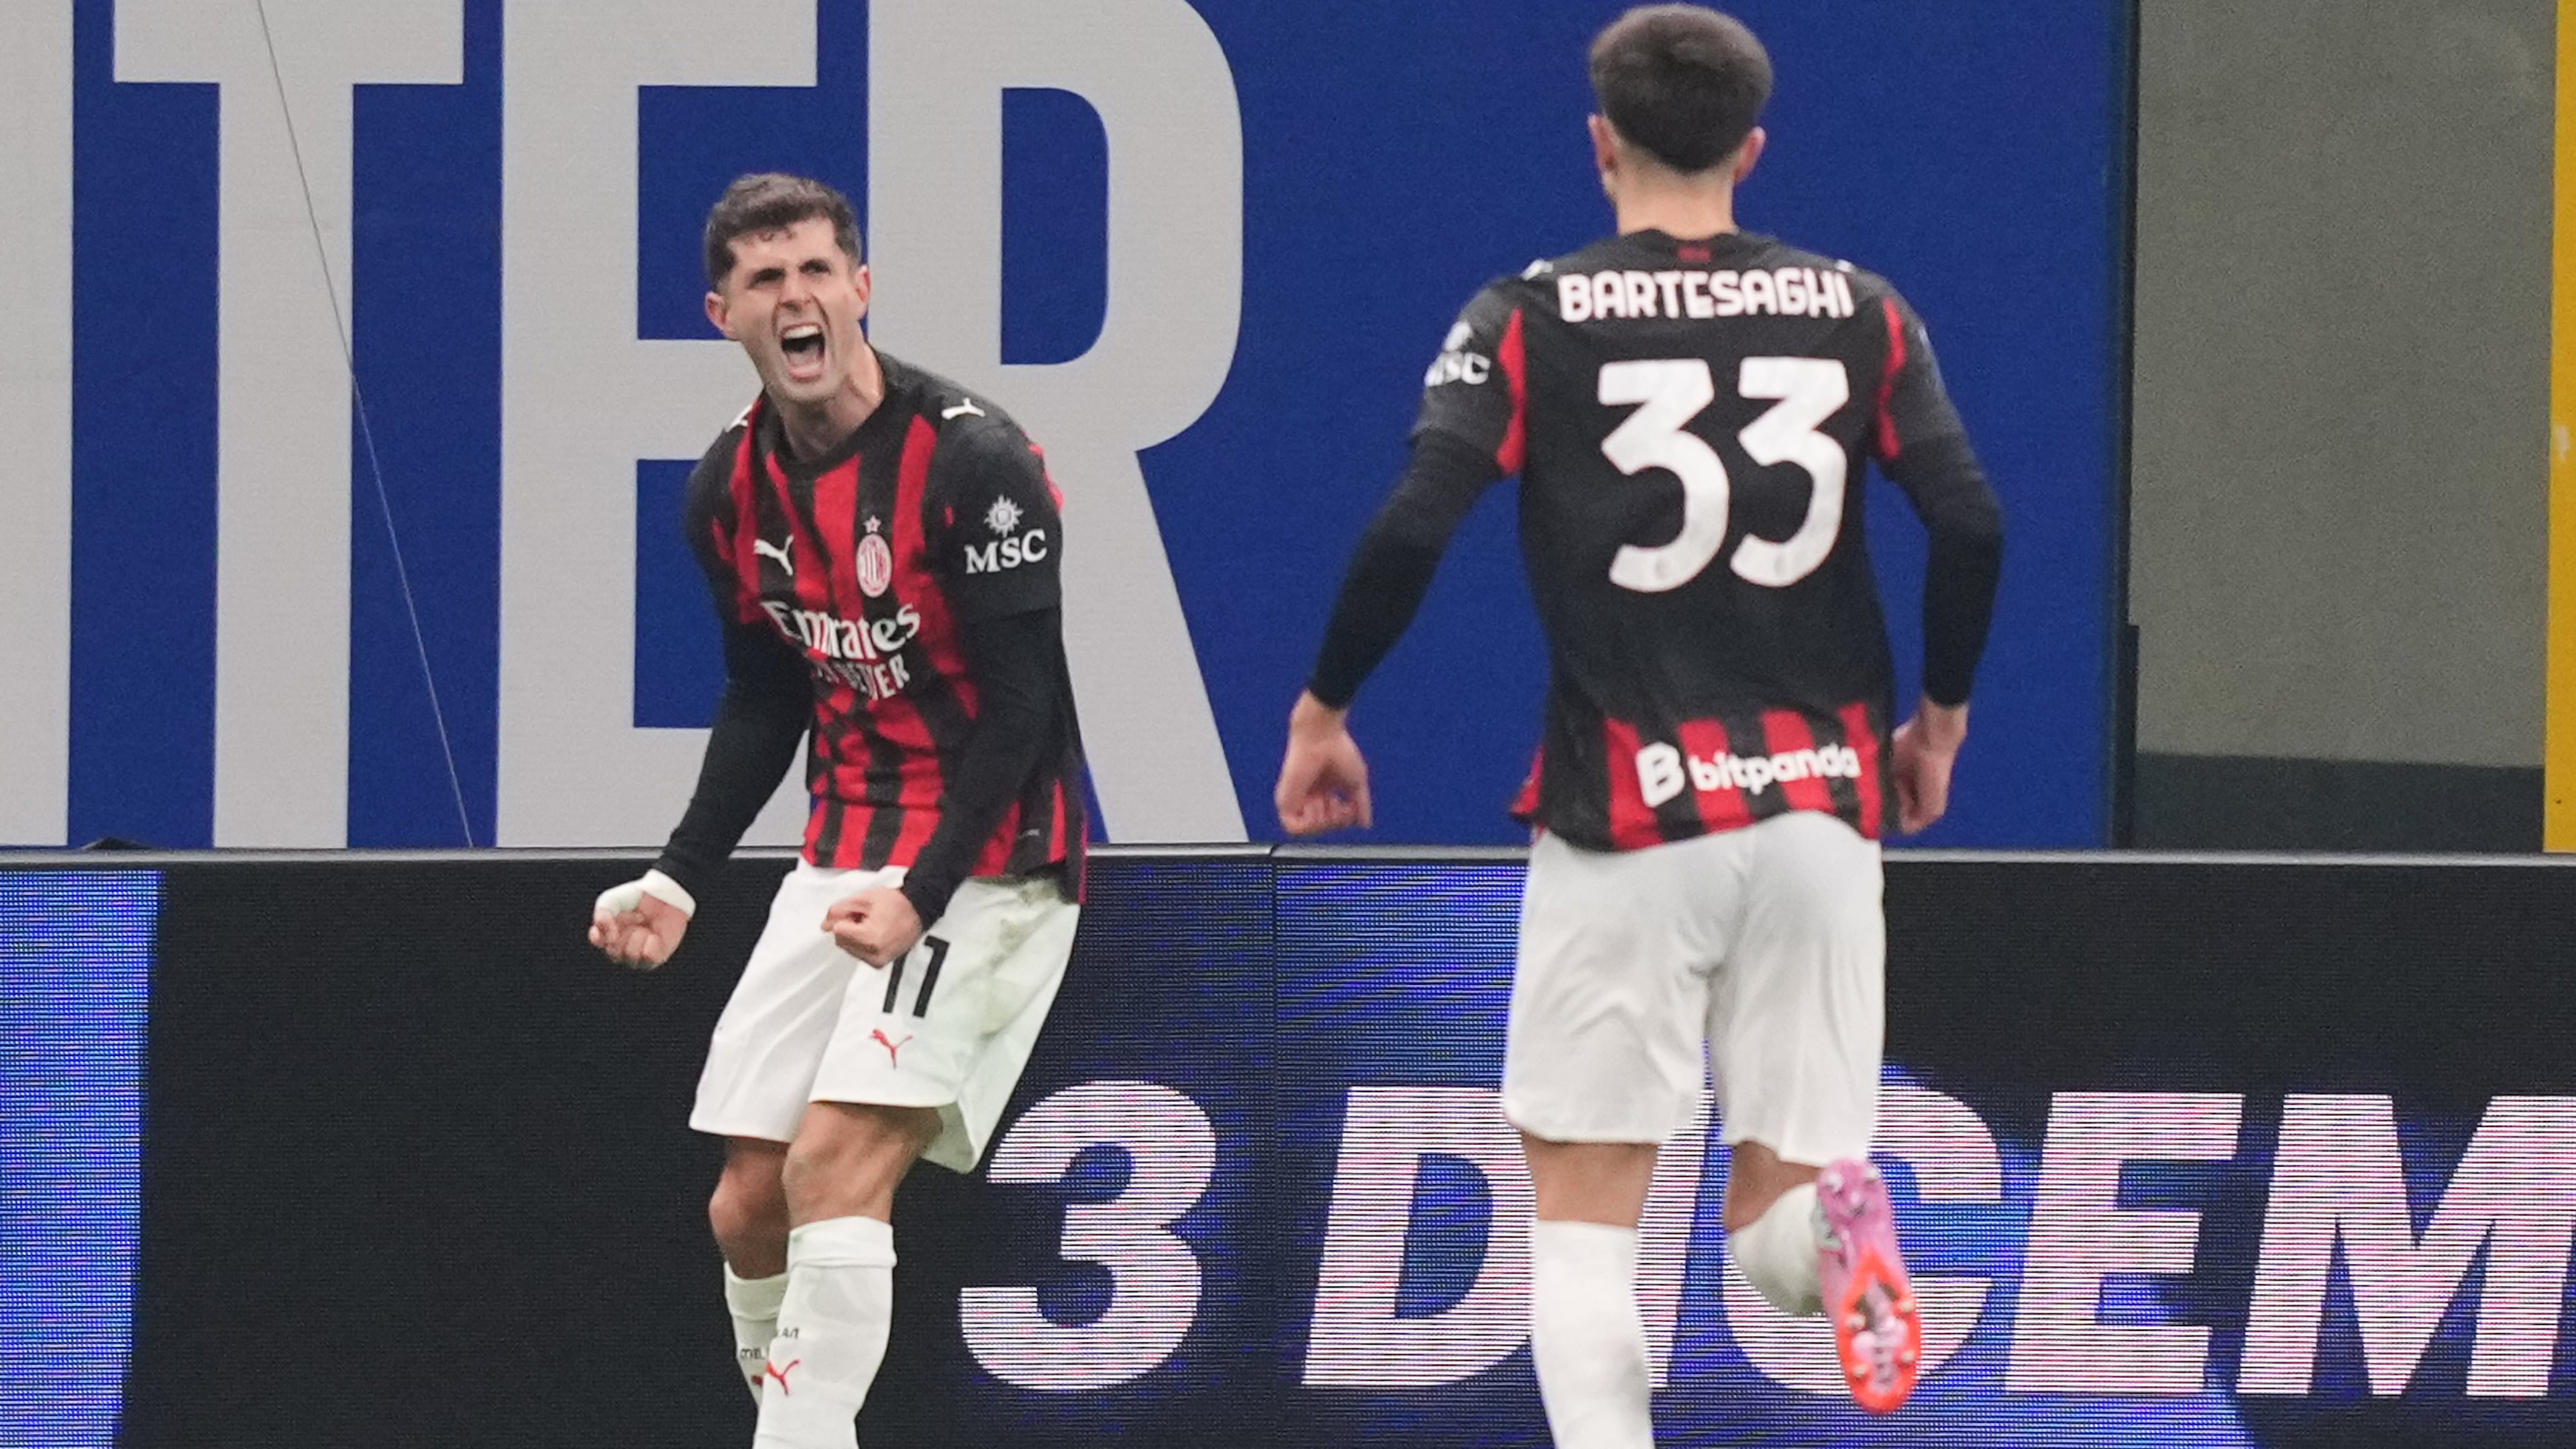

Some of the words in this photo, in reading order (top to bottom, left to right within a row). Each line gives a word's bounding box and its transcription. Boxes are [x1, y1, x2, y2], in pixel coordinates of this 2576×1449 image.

[1556, 268, 1856, 323] BARTESAGHI
[1597, 356, 1849, 593] 33
[964, 528, 1047, 574] MSC
[1687, 743, 1862, 796] bitpanda
[960, 1079, 1217, 1391] 3
